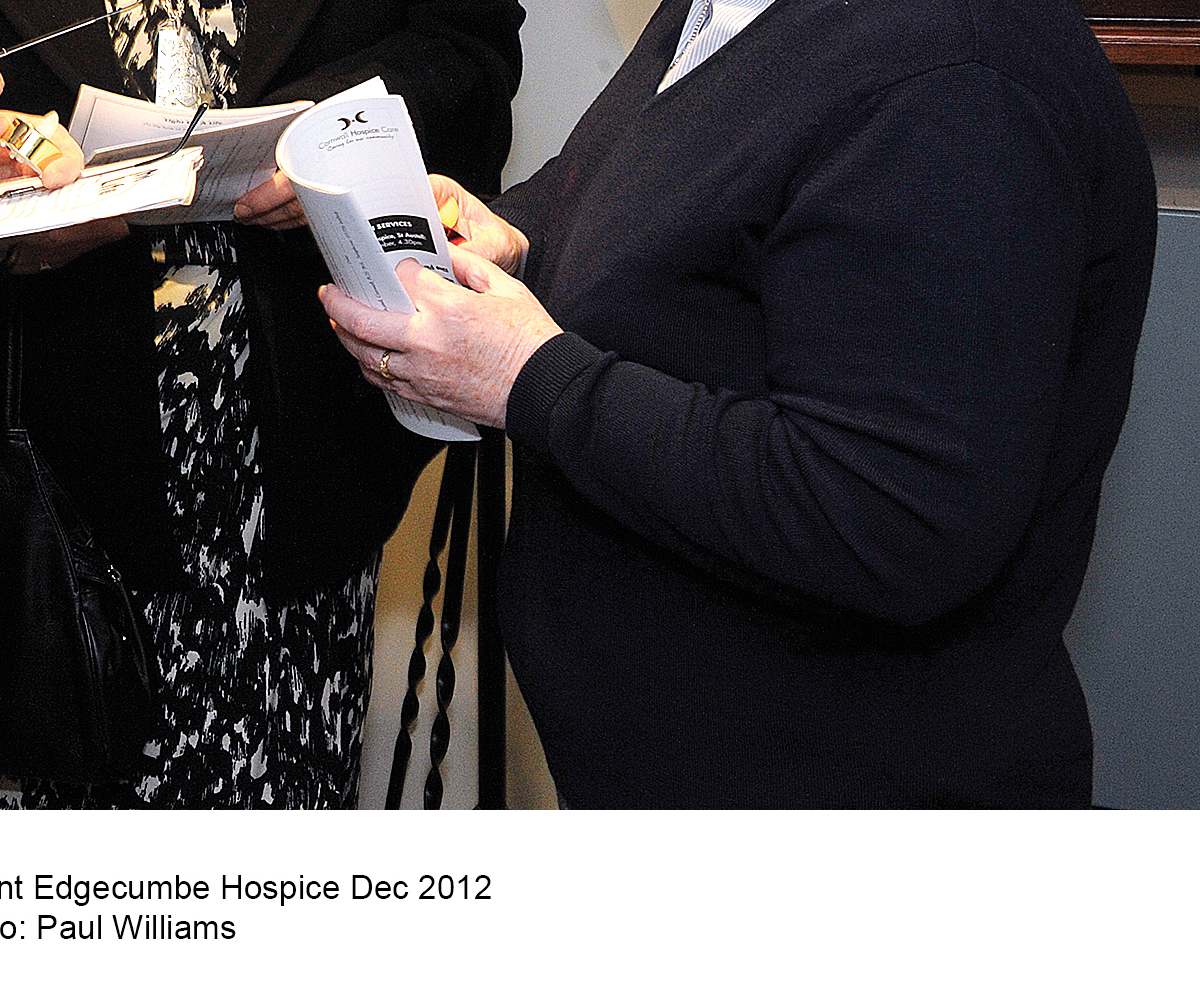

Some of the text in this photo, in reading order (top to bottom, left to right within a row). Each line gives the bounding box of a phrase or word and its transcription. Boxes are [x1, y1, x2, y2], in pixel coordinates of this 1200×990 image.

[319, 132, 348, 150] Cornwall
[350, 127, 380, 137] Hospice
[376, 221, 412, 230] SERVICES
